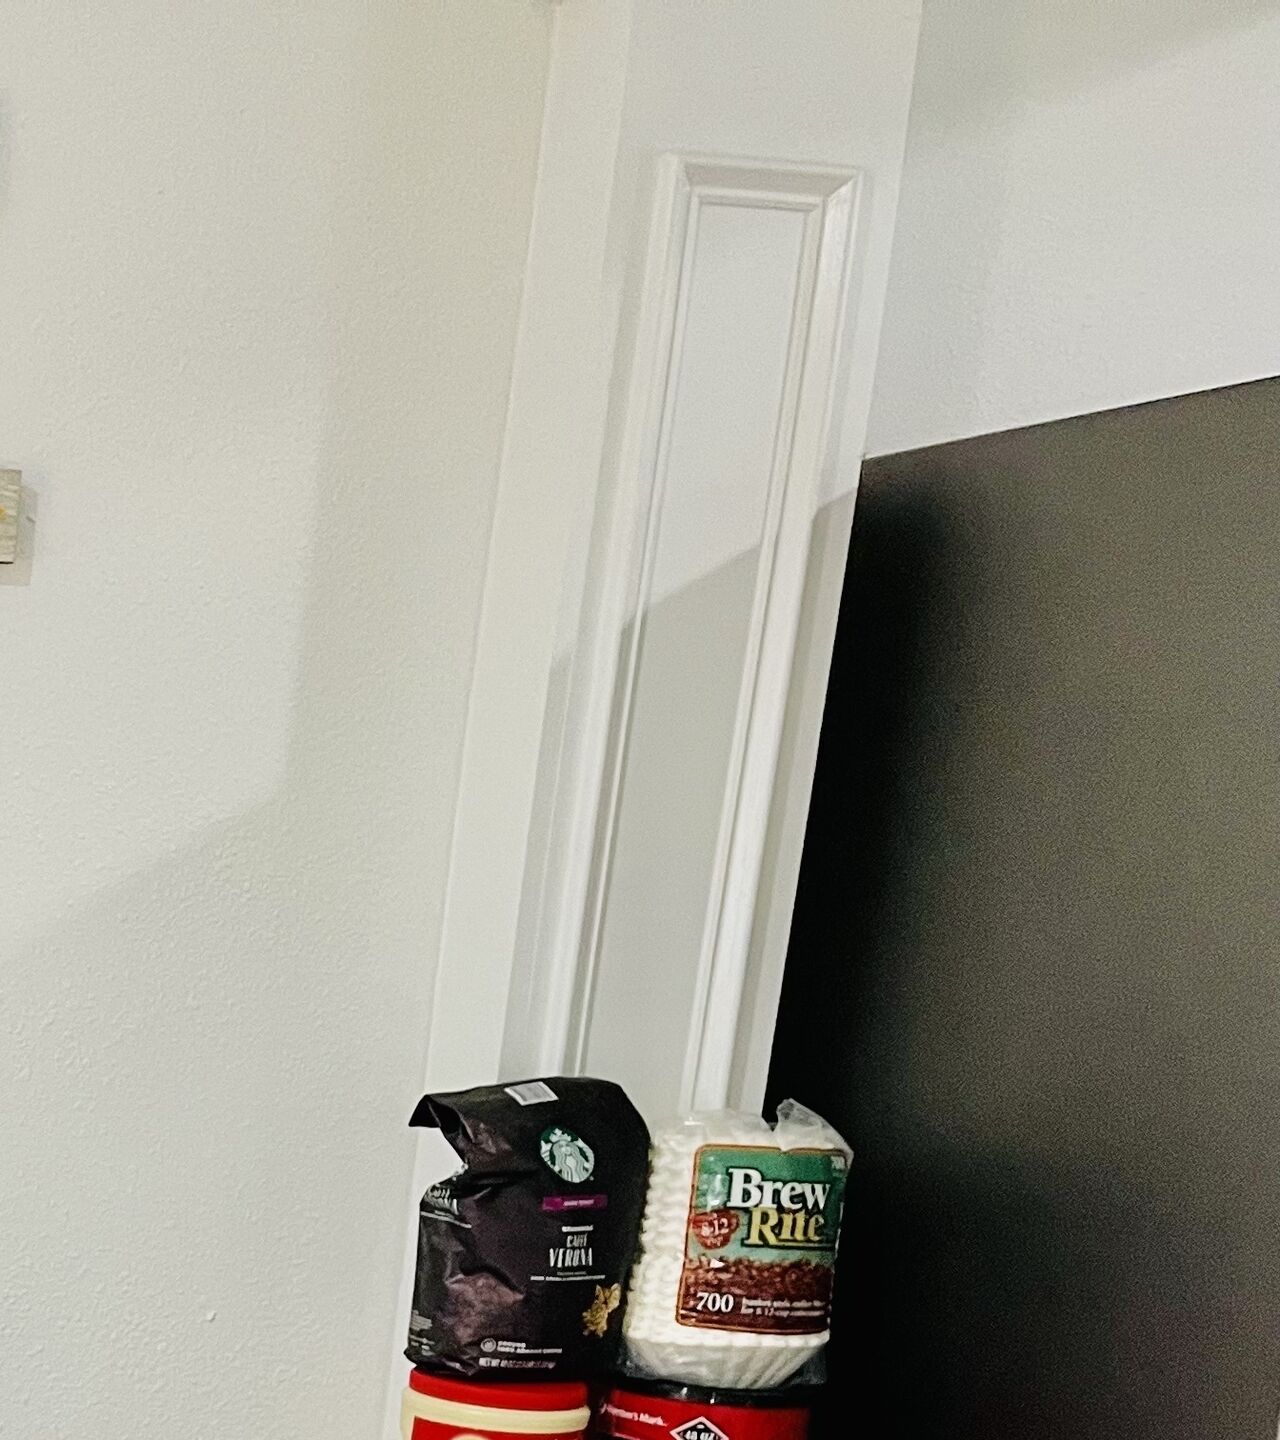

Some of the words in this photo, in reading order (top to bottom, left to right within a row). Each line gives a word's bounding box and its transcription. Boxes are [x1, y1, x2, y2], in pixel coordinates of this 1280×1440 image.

[727, 1168, 831, 1211] Brew
[744, 1205, 825, 1246] Rite
[549, 1247, 593, 1269] VERONA
[695, 1291, 736, 1313] 700
